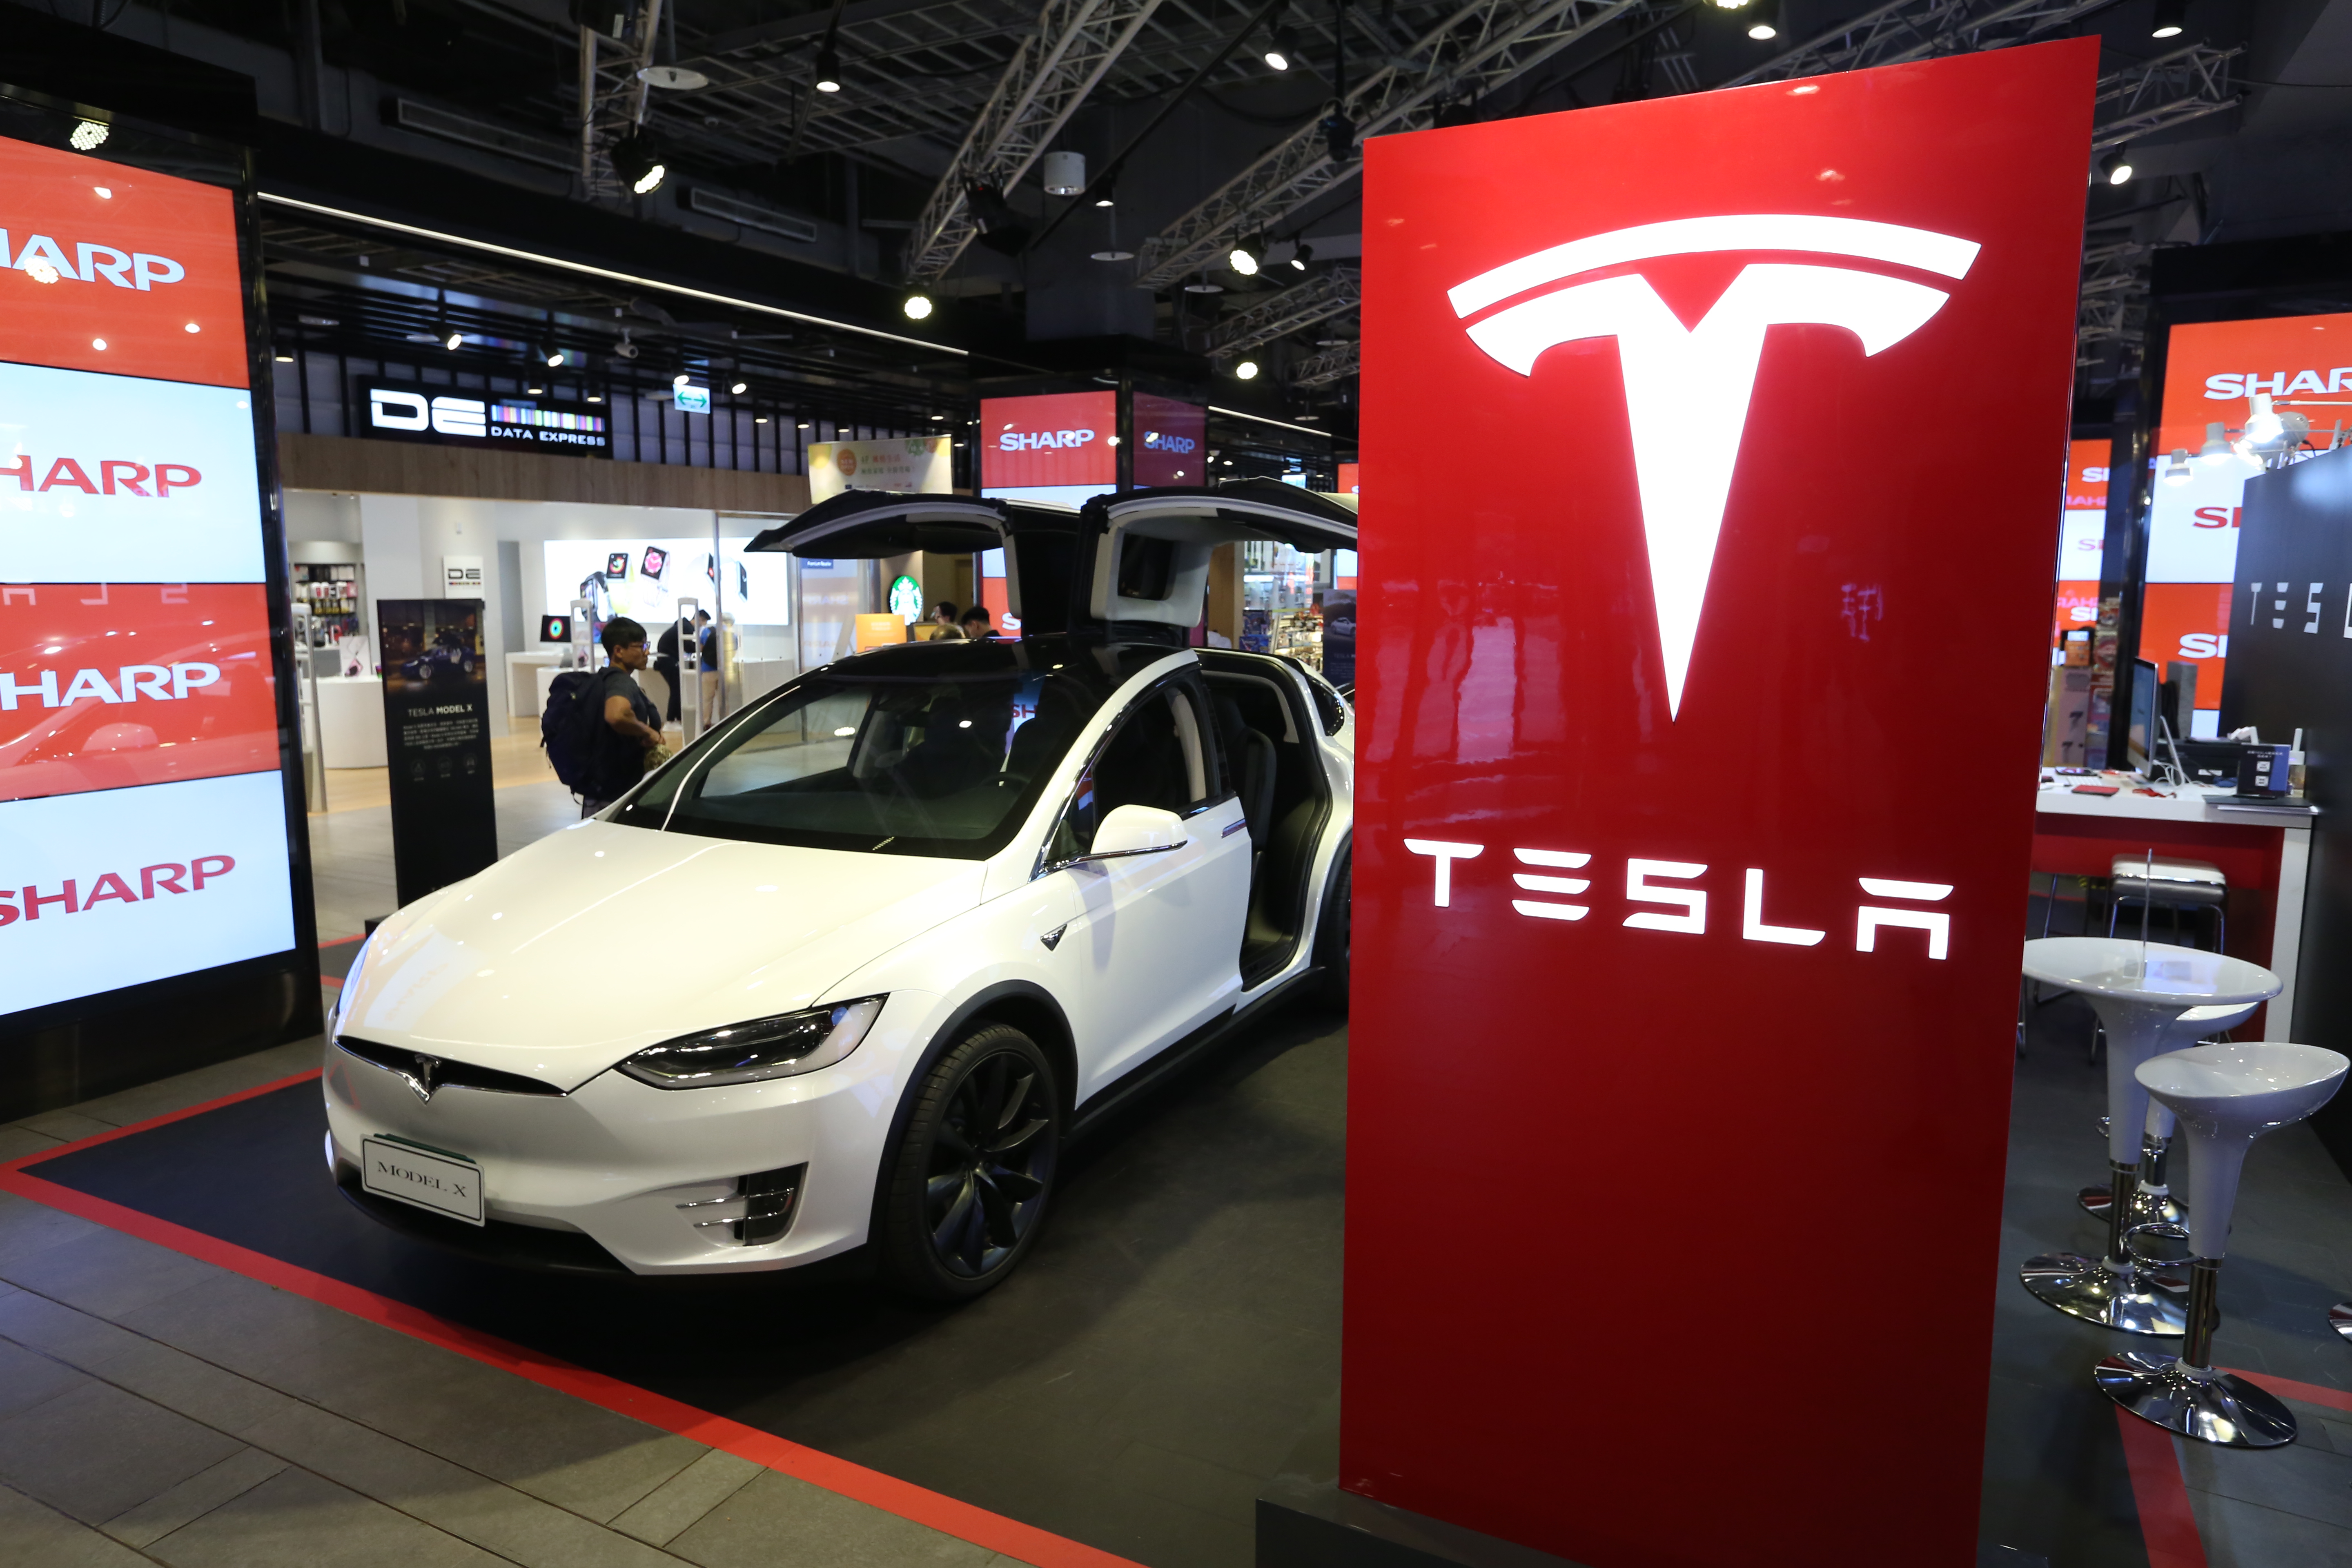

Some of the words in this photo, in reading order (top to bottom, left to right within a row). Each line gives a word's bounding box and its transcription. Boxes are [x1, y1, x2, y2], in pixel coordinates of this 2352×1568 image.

[0, 228, 185, 292] ARP
[370, 388, 487, 437] DE
[491, 426, 534, 440] DATA
[539, 430, 606, 446] EXPRESS
[999, 429, 1095, 451] SHARP
[1145, 431, 1195, 454] SHARP
[436, 704, 465, 714] MODEL
[466, 704, 473, 712] X
[1403, 838, 1954, 960] TESLA
[377, 1161, 448, 1192] MODEL
[452, 1183, 467, 1197] X
